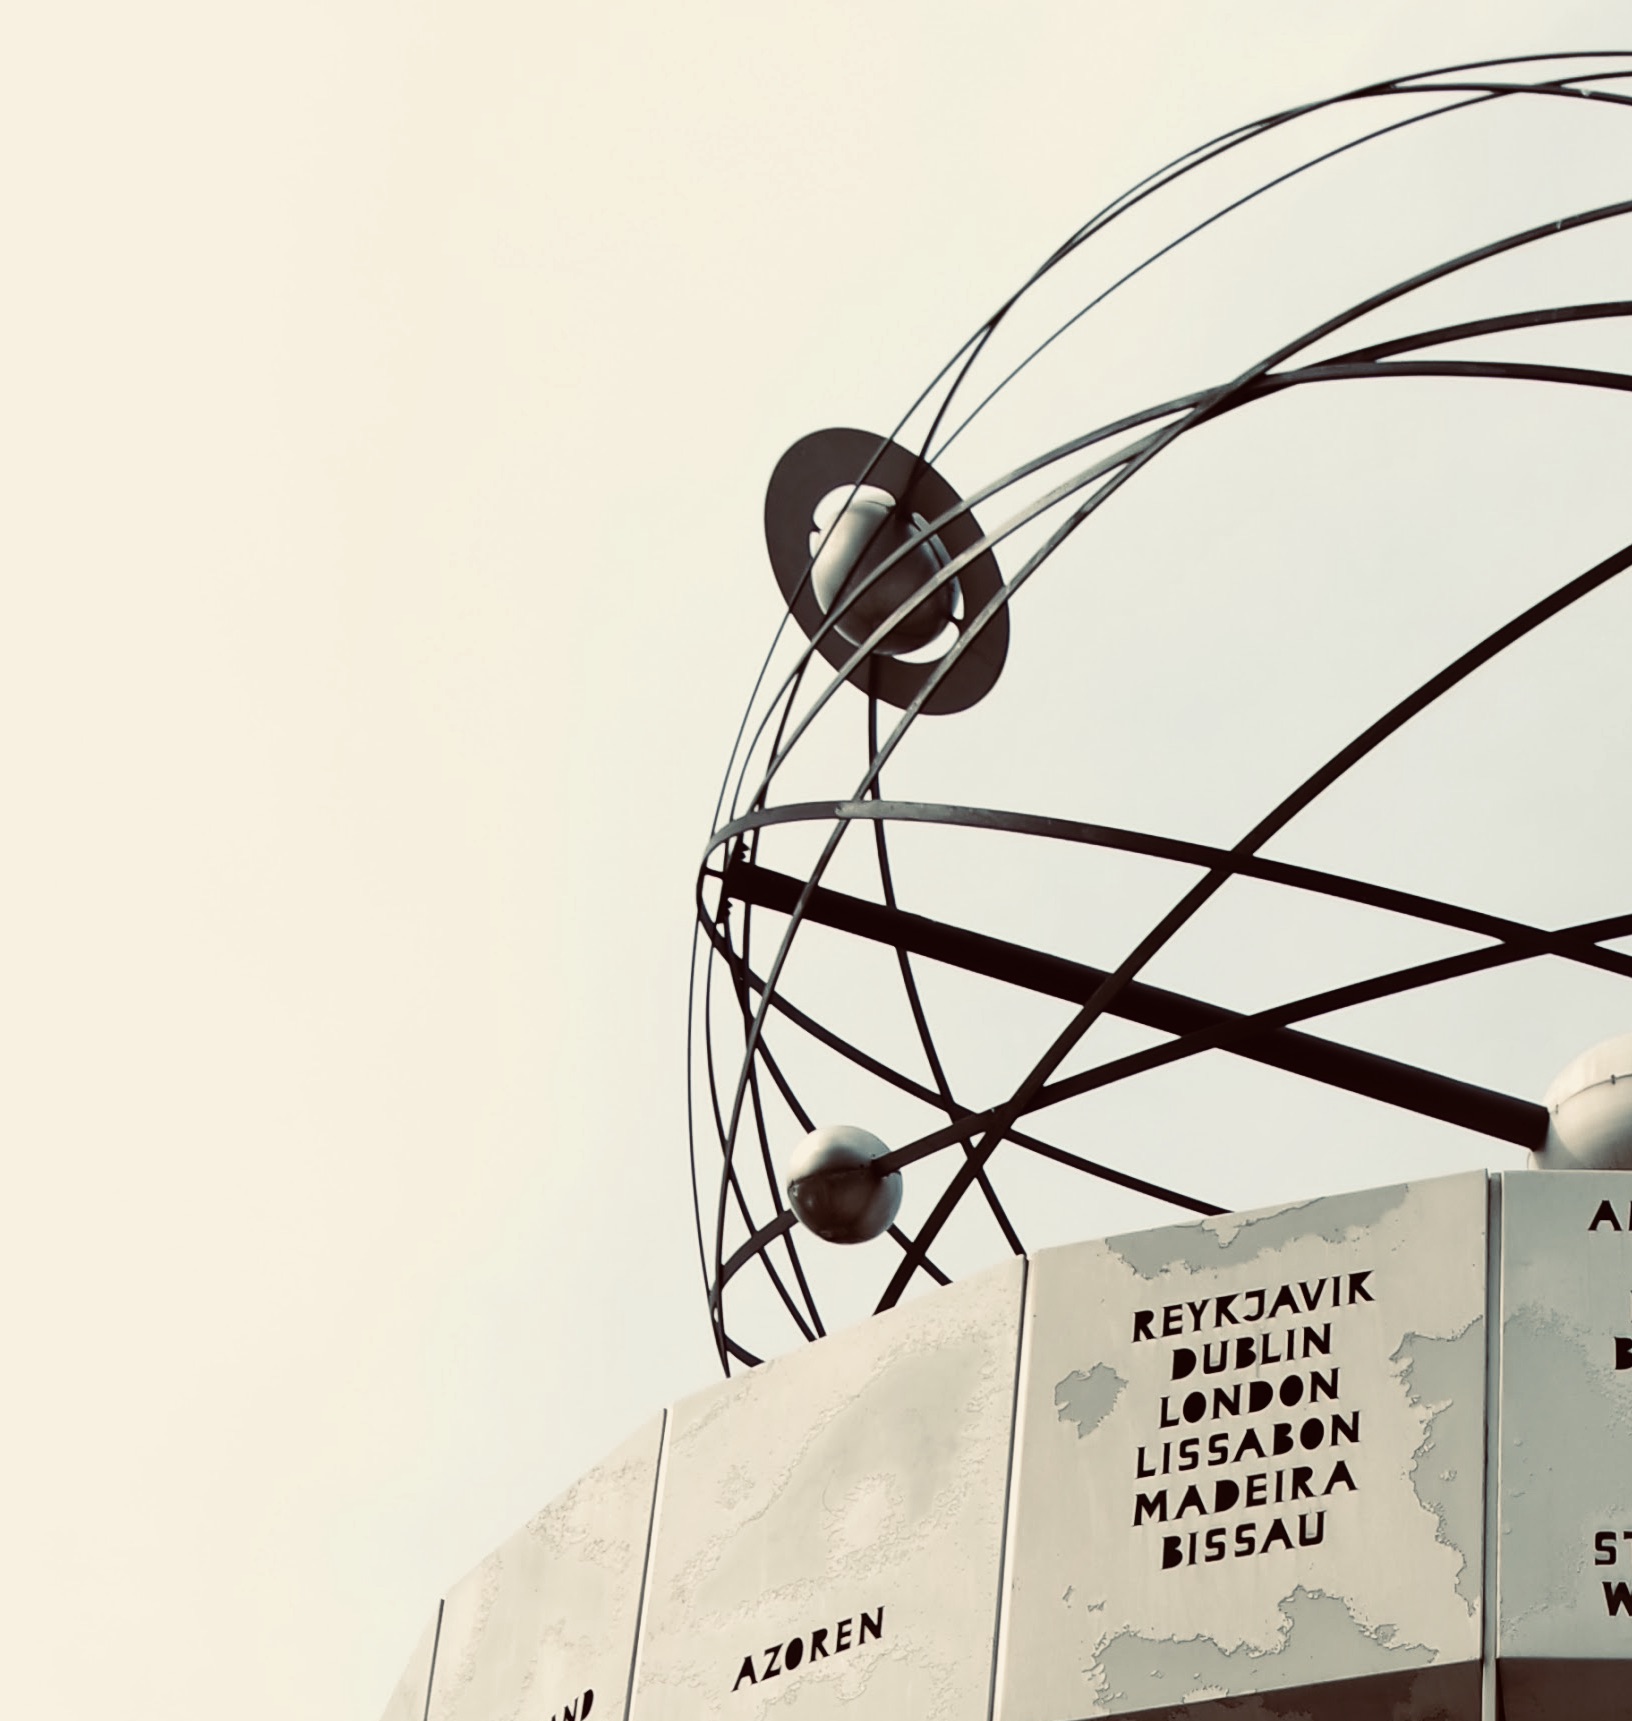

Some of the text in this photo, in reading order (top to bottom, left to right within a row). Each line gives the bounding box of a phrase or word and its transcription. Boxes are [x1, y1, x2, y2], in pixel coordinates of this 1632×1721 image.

[1133, 1270, 1374, 1343] REYKJAVIK
[1172, 1323, 1331, 1381] DUBLIN
[1160, 1367, 1339, 1429] LONDON
[1137, 1411, 1360, 1479] LISSABON
[1133, 1460, 1357, 1527] MADEIRA
[1162, 1511, 1325, 1570] BISSAU
[732, 1606, 883, 1692] AZOREN
